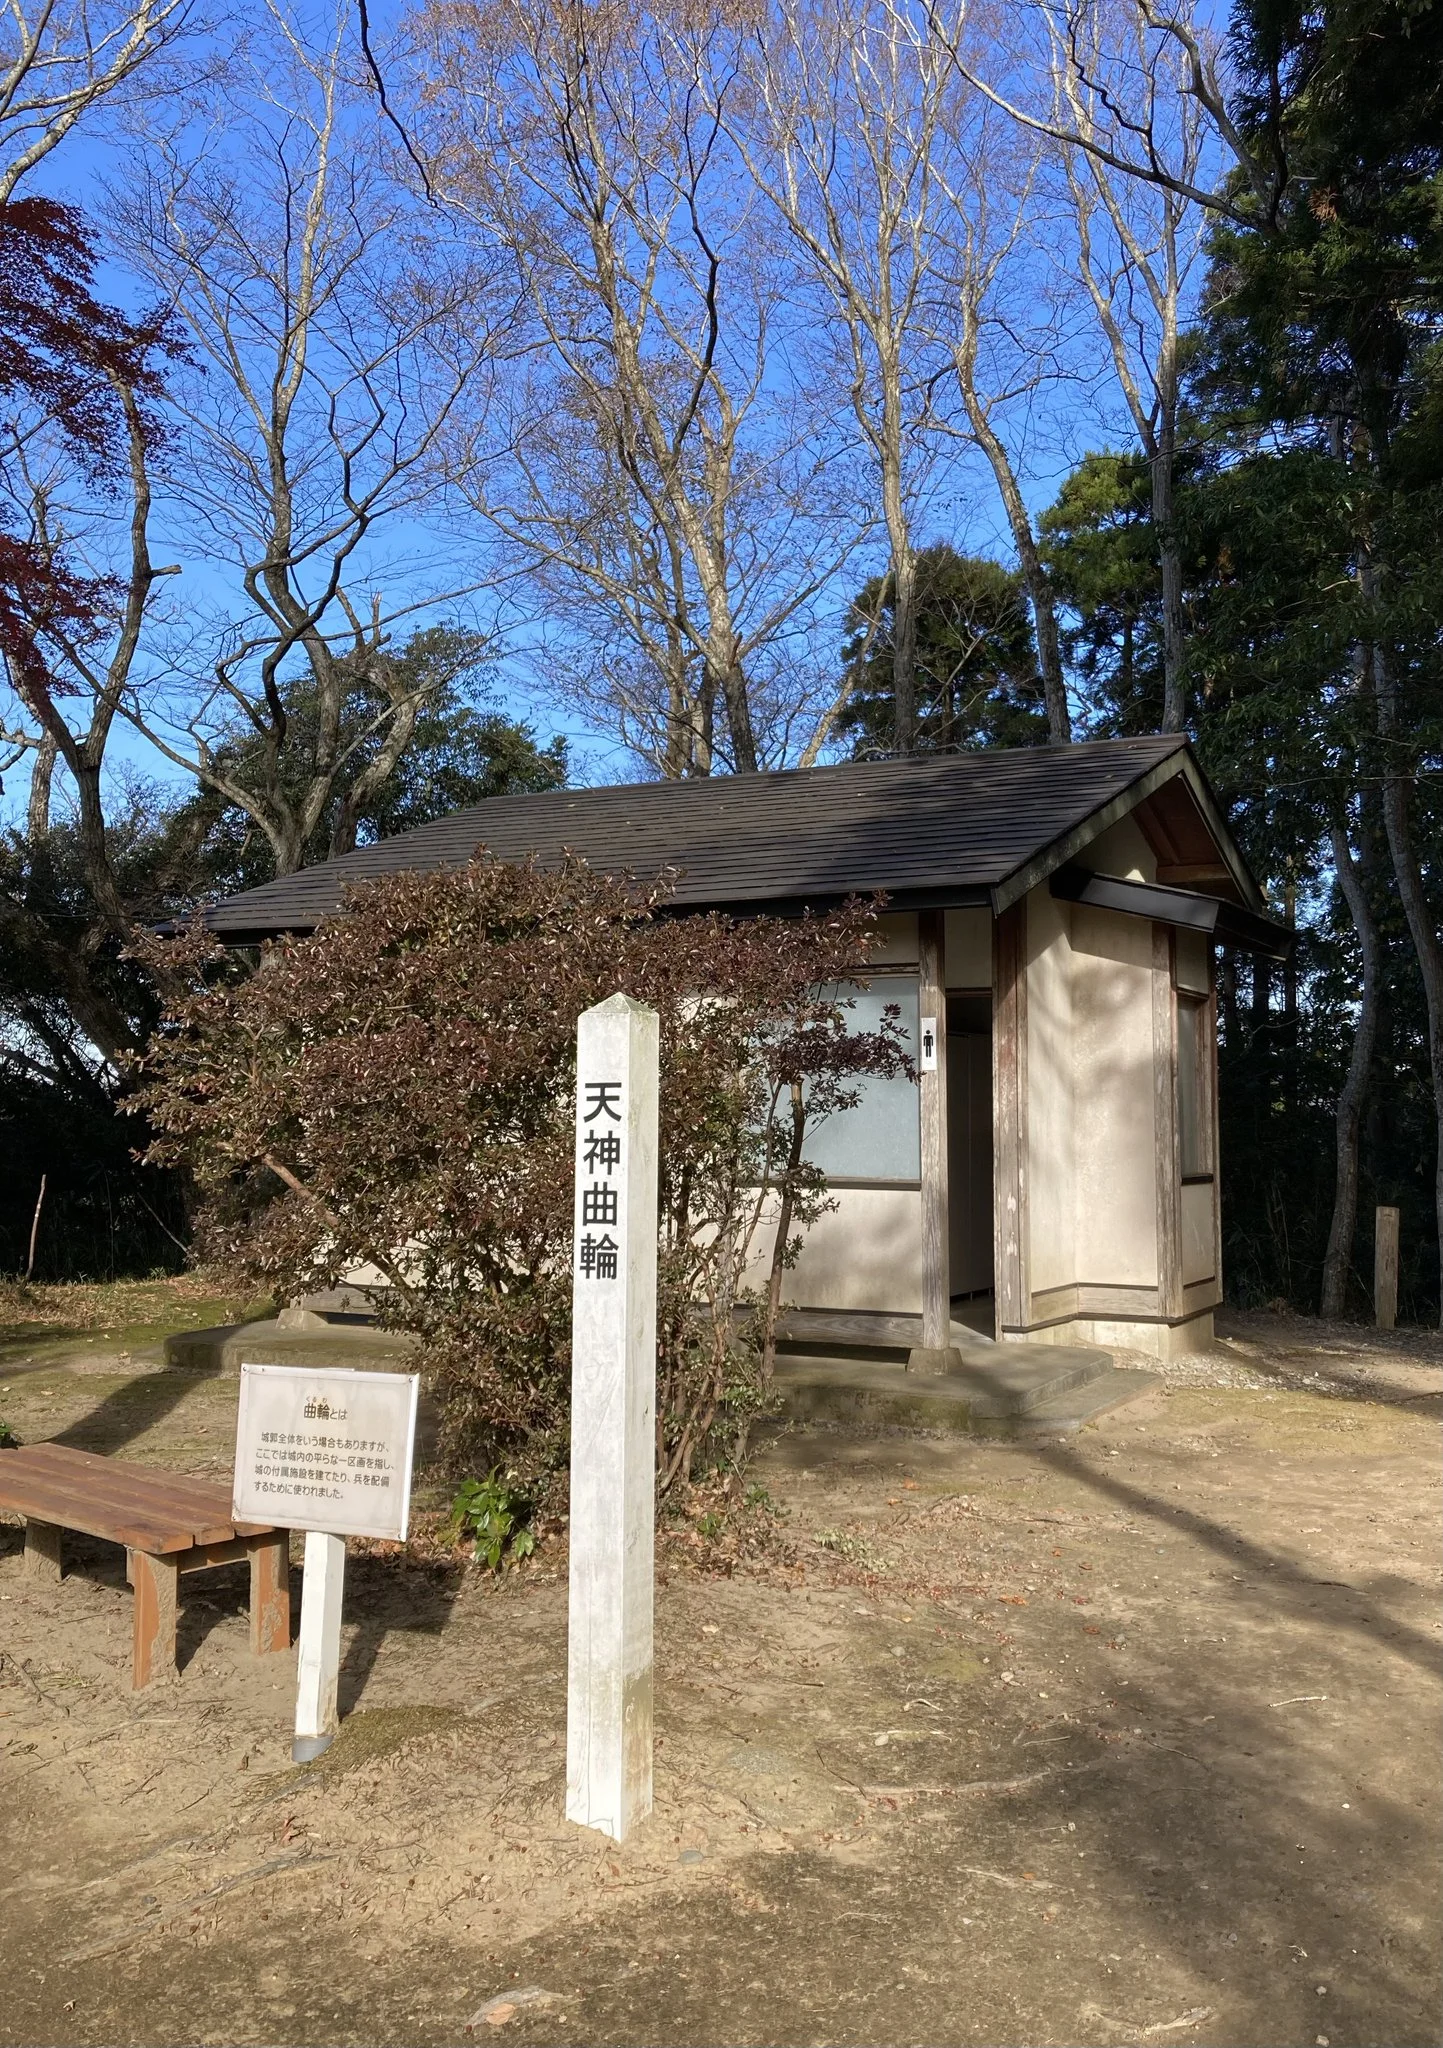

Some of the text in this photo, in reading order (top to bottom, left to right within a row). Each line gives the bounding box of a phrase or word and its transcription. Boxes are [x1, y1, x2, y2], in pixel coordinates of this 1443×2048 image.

[579, 1082, 622, 1279] 天神曲輪
[304, 1402, 348, 1420] 曲輪とは
[254, 1481, 344, 1499] するために使われました。
